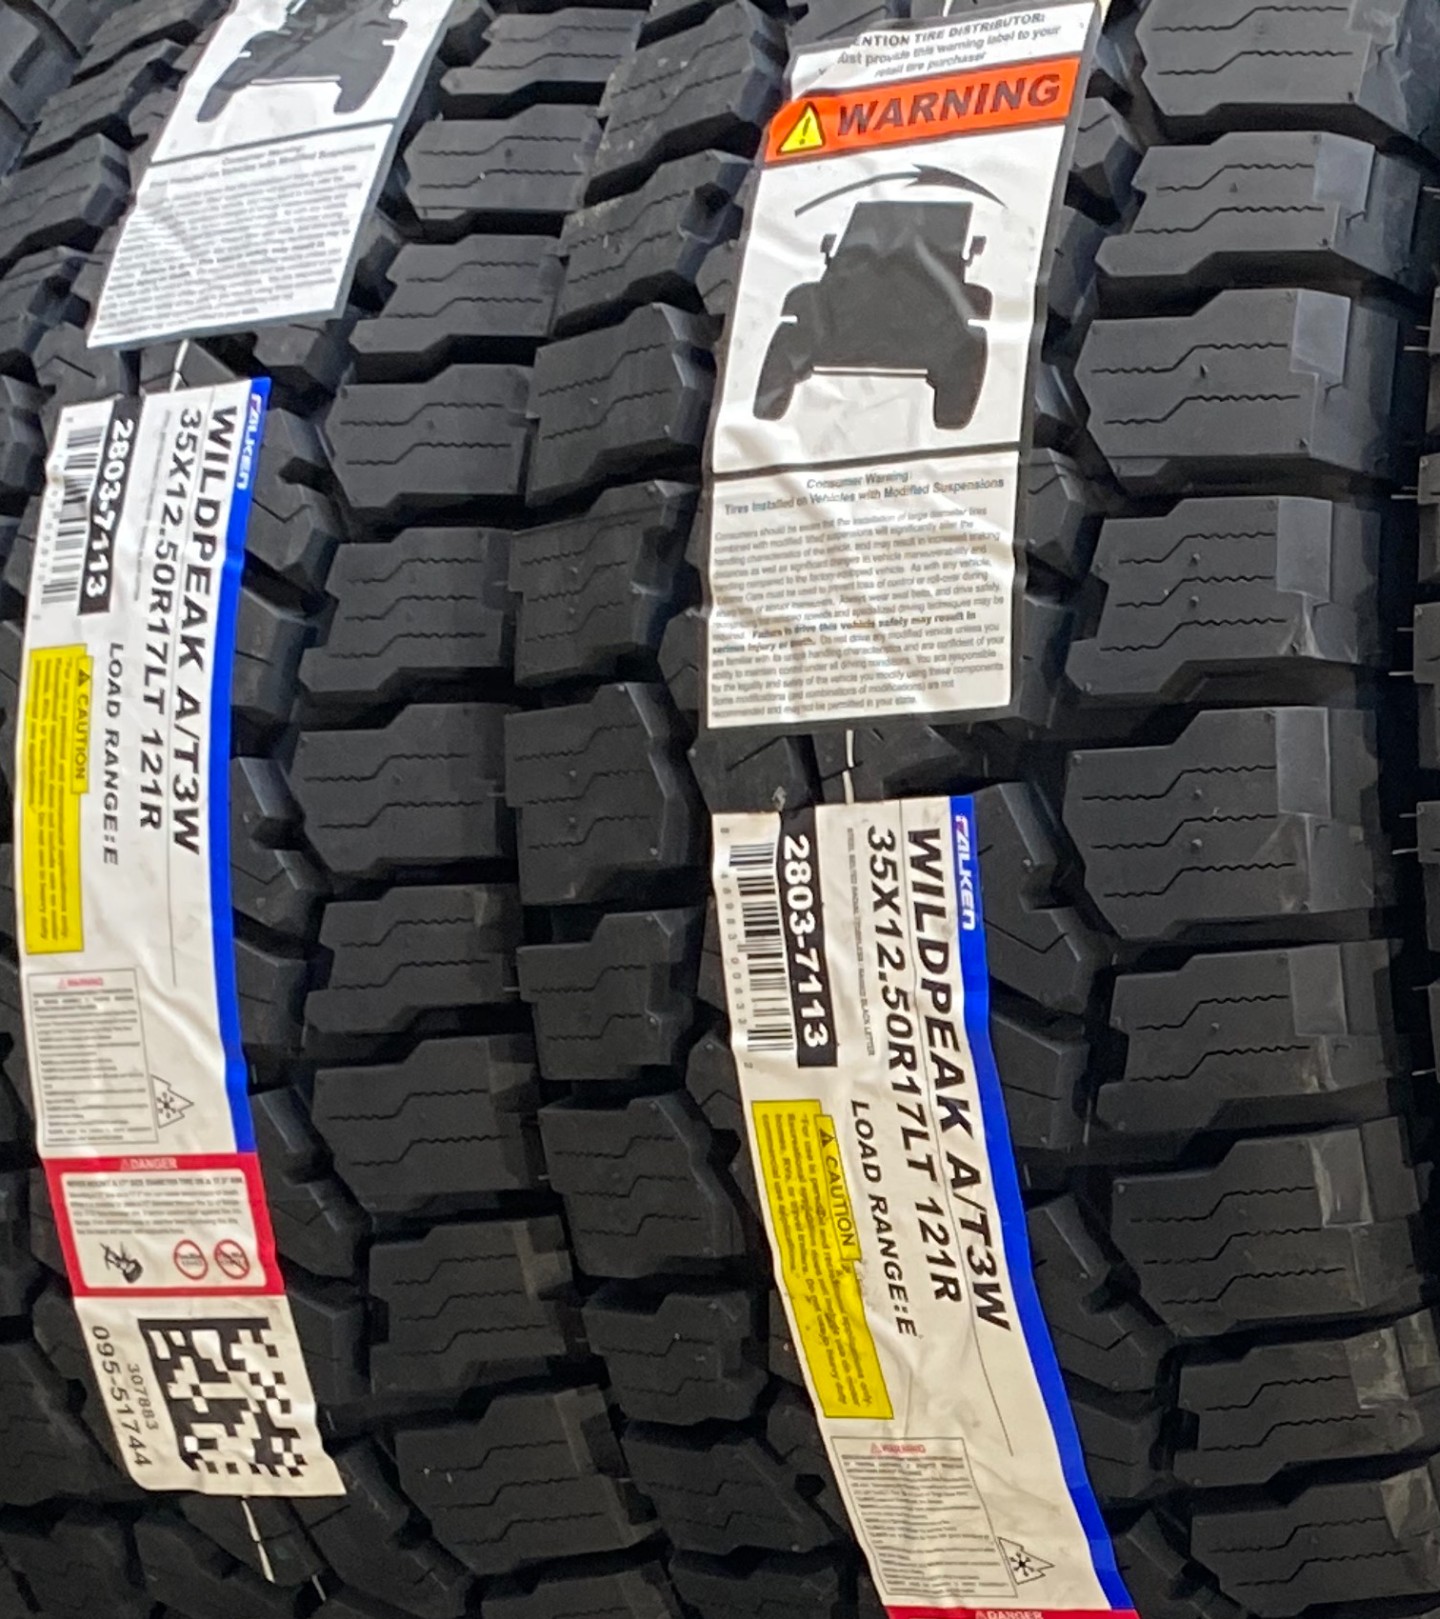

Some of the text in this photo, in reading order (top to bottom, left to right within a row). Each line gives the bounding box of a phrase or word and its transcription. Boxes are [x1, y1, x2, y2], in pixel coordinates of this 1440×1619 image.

[875, 64, 904, 78] retail
[913, 45, 934, 58] this
[937, 39, 984, 57] warning
[987, 31, 1014, 46] label
[1017, 28, 1030, 41] to
[1031, 26, 1060, 42] your
[914, 29, 945, 43] TIRE
[948, 13, 1045, 38] DISTRIBUTOR:
[837, 74, 1060, 137] WARNING
[236, 394, 262, 490] FALKEN
[806, 474, 862, 490] Consumer
[86, 419, 134, 597] 2803-7113
[724, 502, 748, 515] Tires
[809, 490, 855, 505] Vehicles
[858, 488, 882, 501] with
[884, 482, 929, 498] Modified
[932, 475, 1004, 495] Suspensions
[143, 409, 201, 715] 35X12.50R17LT
[172, 406, 237, 856] WILDPEAK A/T3W
[75, 695, 89, 780] CAUTION
[103, 643, 125, 866] LOAD RANGE:E
[140, 729, 165, 830] 121R
[955, 812, 976, 932] FALKEN
[783, 834, 829, 1049] 2803-7113
[867, 825, 962, 1304] 35X12.50R17LT 121R
[908, 828, 1012, 1332] WILDPEAK A/T3W
[130, 1157, 179, 1170] DANGER
[825, 1155, 857, 1247] CAUTION
[851, 1100, 918, 1338] LOAD RANGE:E
[92, 1325, 153, 1467] 095-51744
[128, 1363, 159, 1431] 307883
